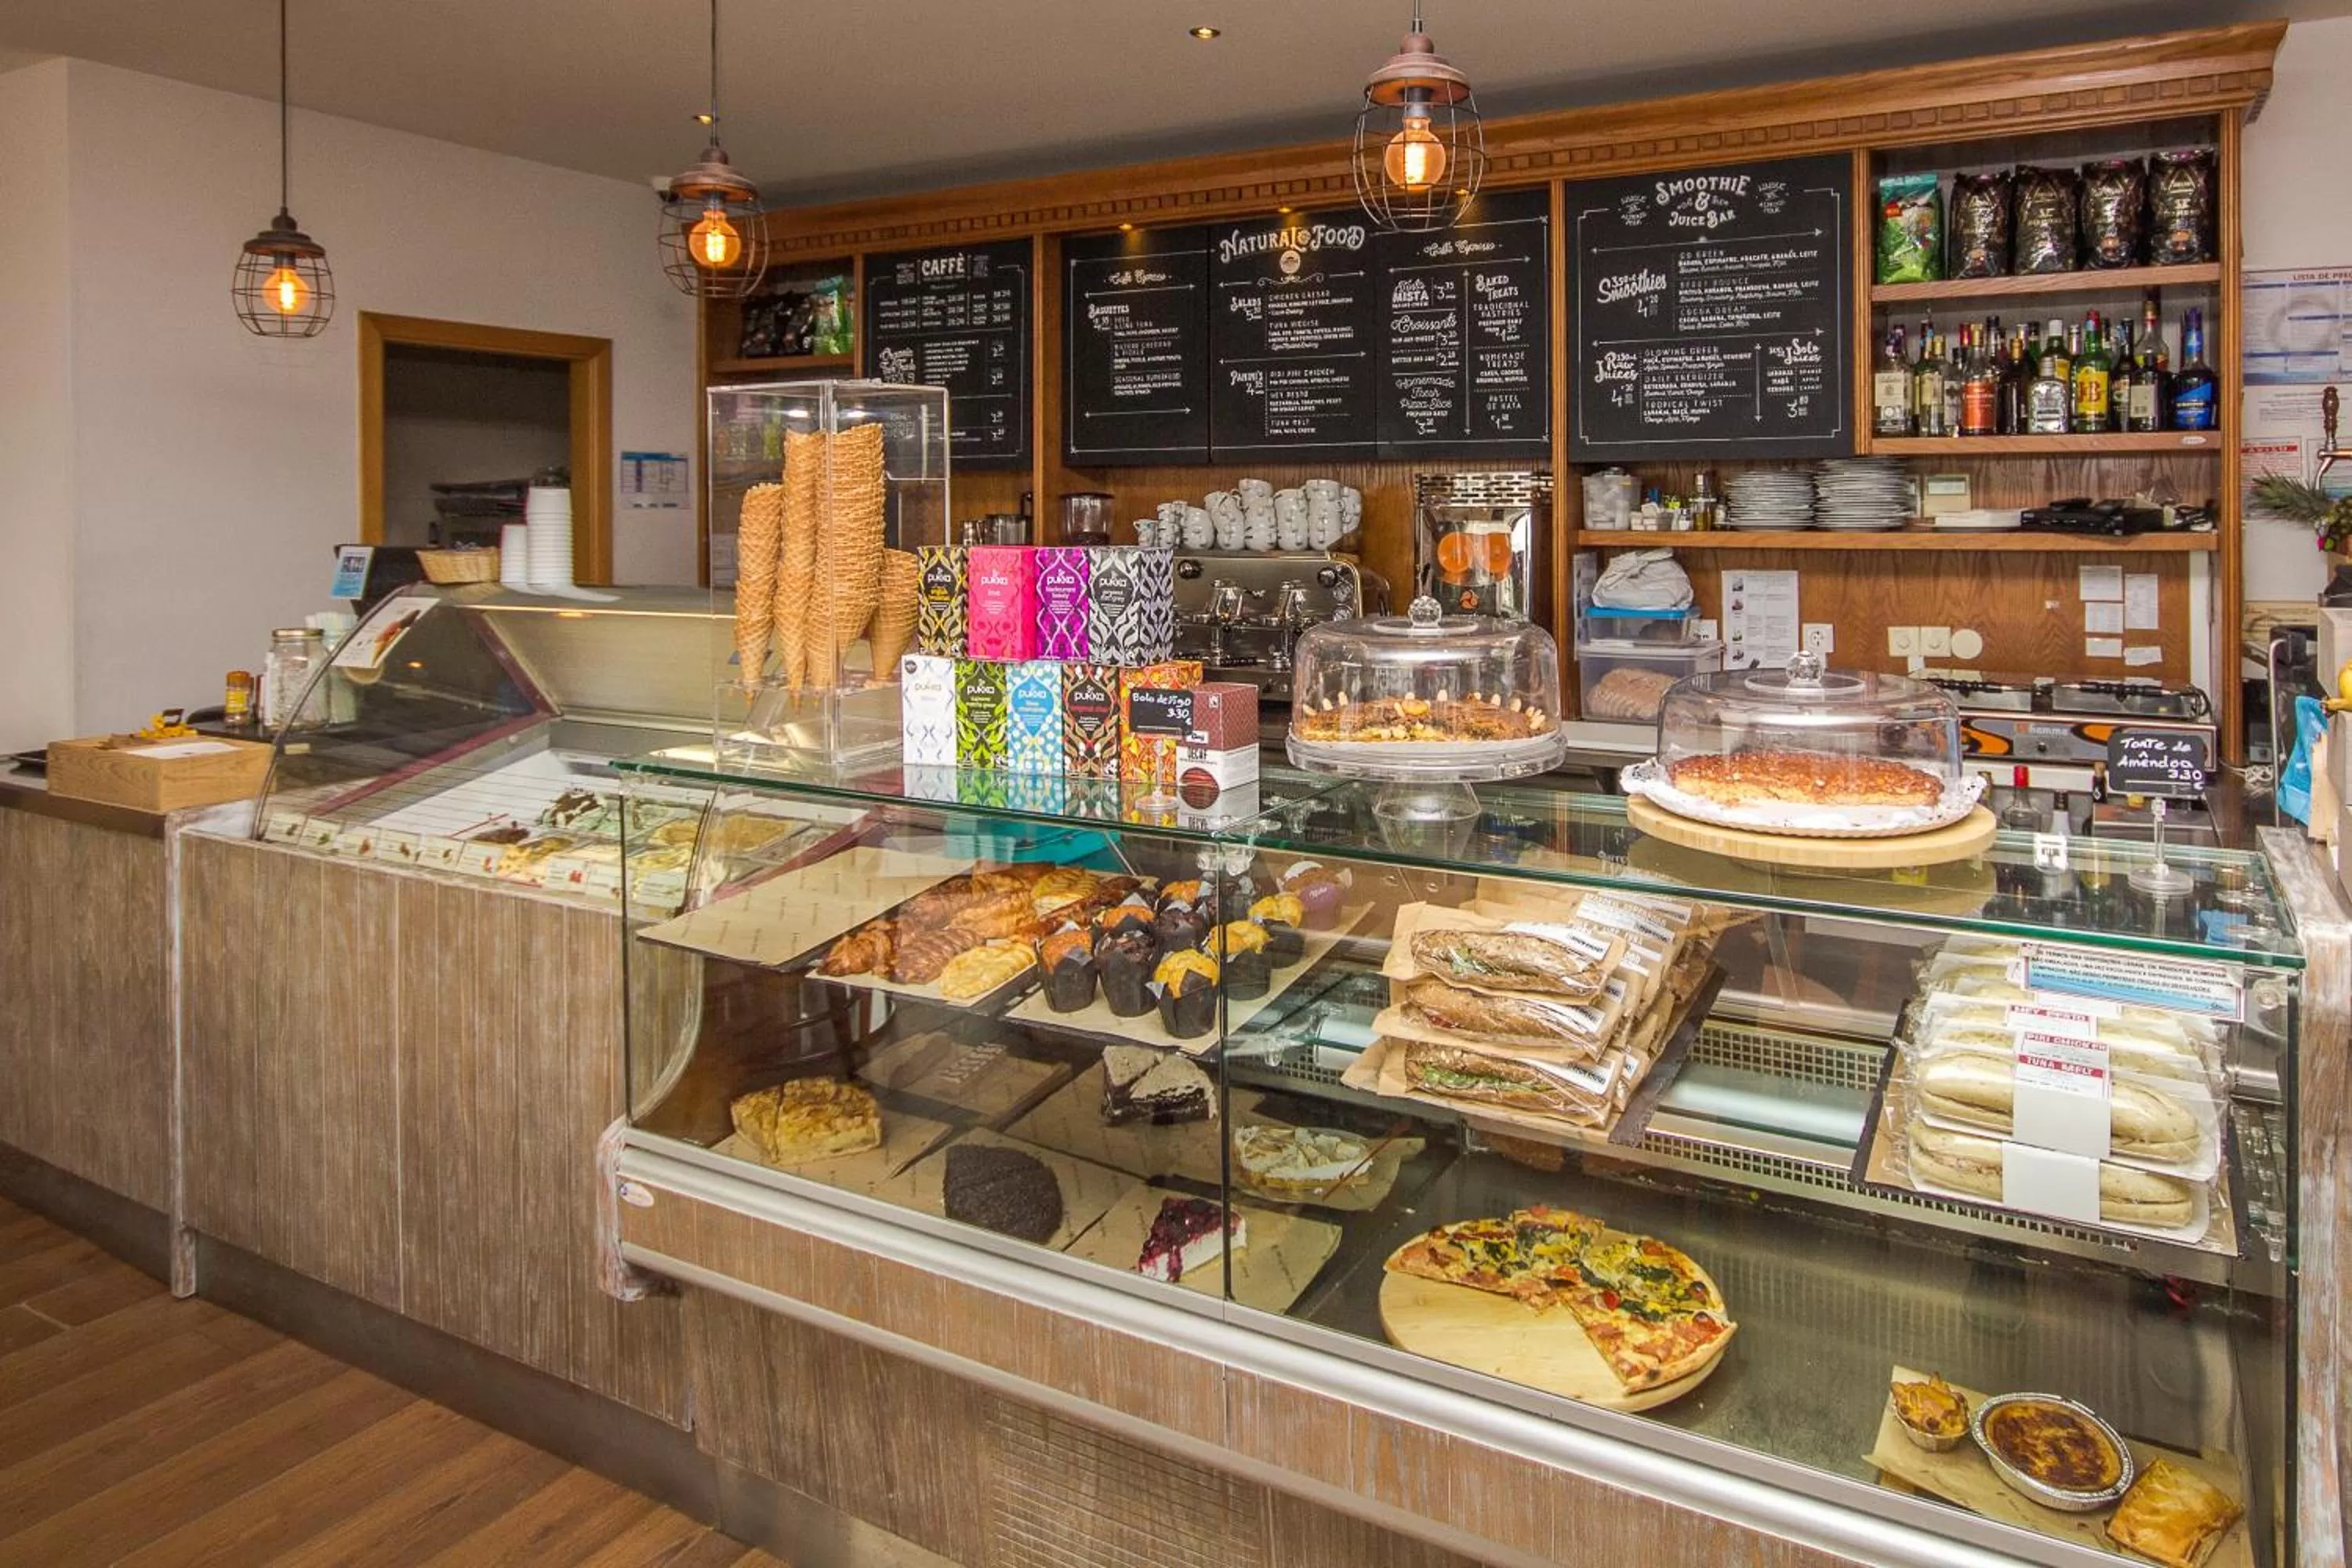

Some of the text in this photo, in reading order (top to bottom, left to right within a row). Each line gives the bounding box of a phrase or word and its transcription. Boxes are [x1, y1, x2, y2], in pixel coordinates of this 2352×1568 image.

[1655, 175, 1751, 205] SMOOTHIE
[1668, 209, 1737, 229] JUICE BAR
[1219, 224, 1366, 263] NATURAL FOOD
[921, 252, 965, 275] CAFFÈ
[1597, 267, 1667, 303] Smoothies
[1392, 290, 1429, 303] MISTA
[1047, 576, 1075, 586] pukka
[1099, 578, 1127, 587] pukka
[967, 685, 995, 695] pukka
[1018, 690, 1047, 699] pukka
[1074, 691, 1105, 702] pukka
[1132, 692, 1155, 702] Bolo
[2116, 750, 2194, 768] Amêndoa
